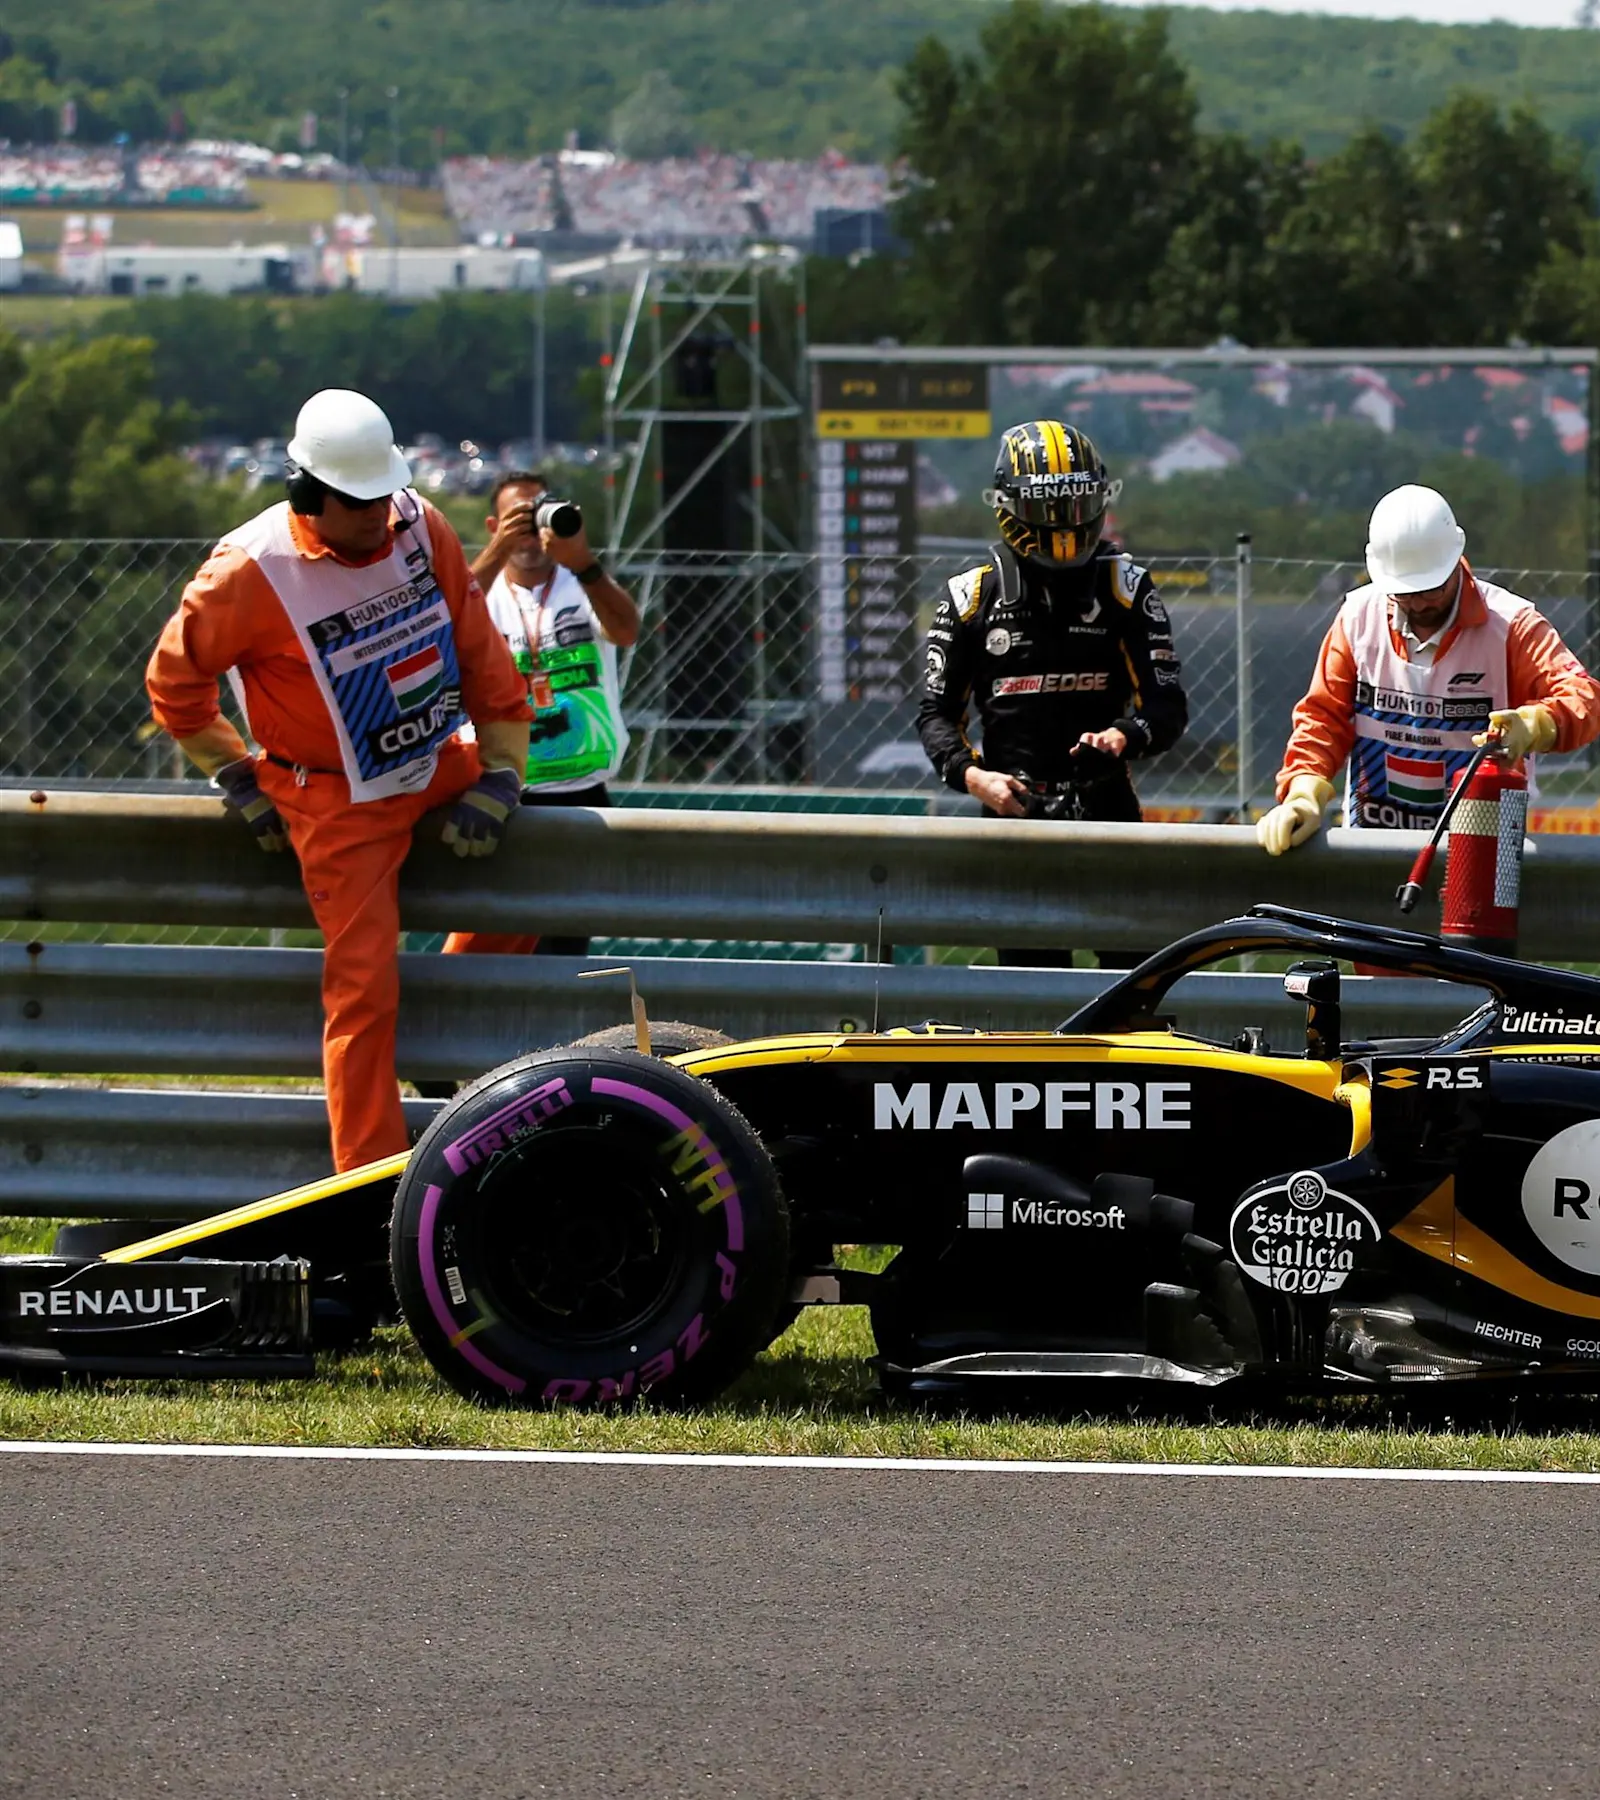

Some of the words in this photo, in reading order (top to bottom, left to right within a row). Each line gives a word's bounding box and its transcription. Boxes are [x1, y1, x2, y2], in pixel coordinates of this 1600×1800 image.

[1019, 482, 1100, 500] RENAULT
[1029, 471, 1091, 485] MAPFRE
[1041, 673, 1110, 693] EDGE
[1503, 1004, 1517, 1016] bp
[1426, 1066, 1483, 1090] R.S.
[874, 1082, 1192, 1131] MAPFRE
[443, 1077, 574, 1177] PIRELLI
[1012, 1199, 1126, 1230] Microsoft
[1247, 1204, 1363, 1241] Estrella
[1252, 1235, 1354, 1271] Galicia
[19, 1286, 207, 1317] RENAULT
[1474, 1320, 1543, 1350] HECHTER
